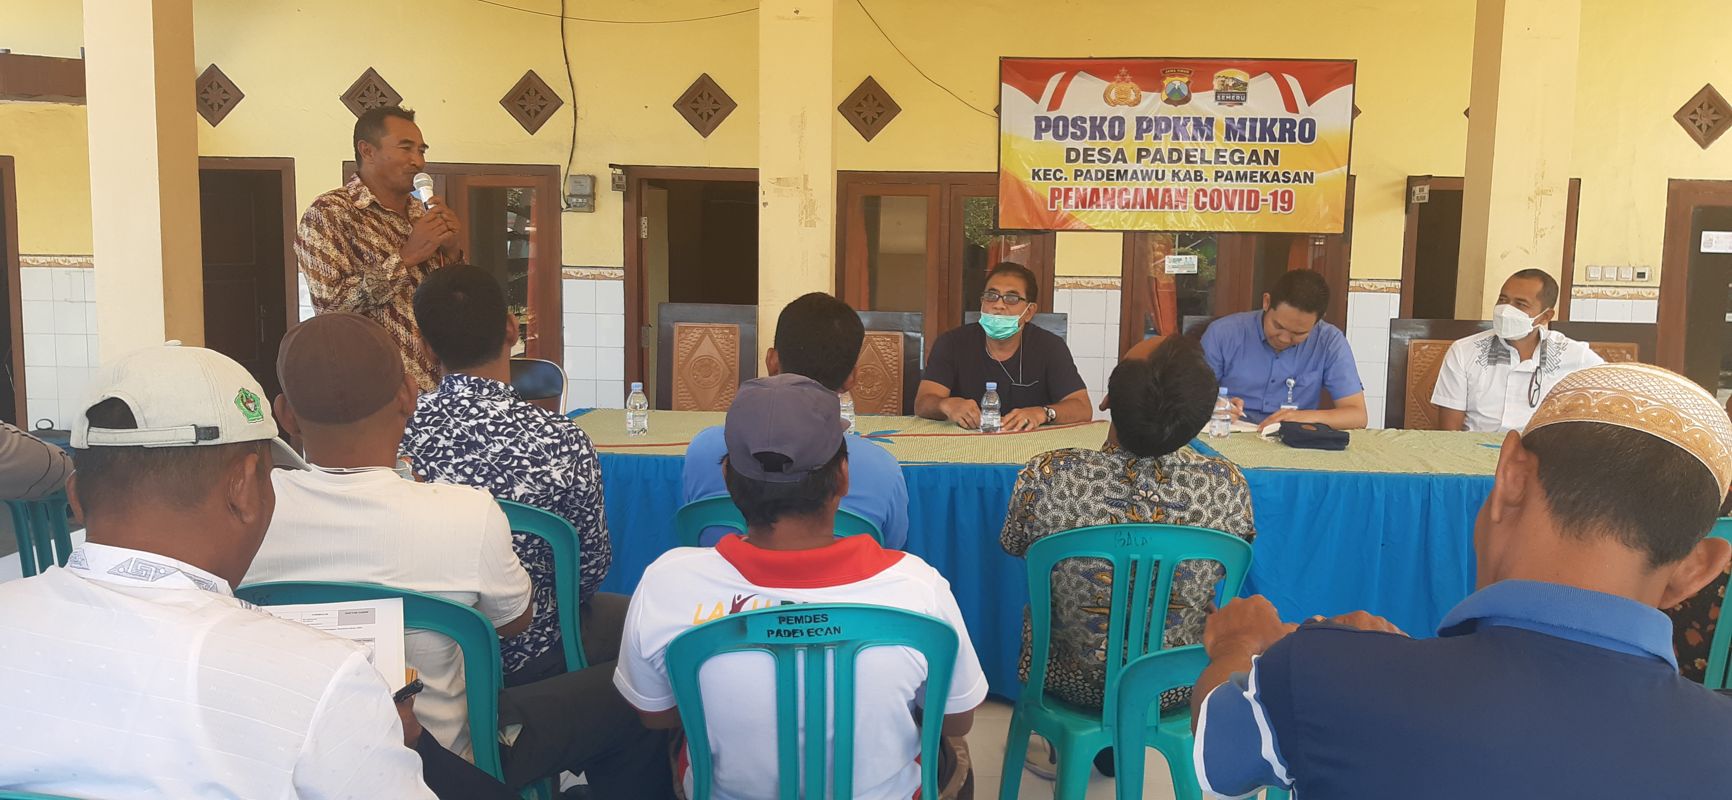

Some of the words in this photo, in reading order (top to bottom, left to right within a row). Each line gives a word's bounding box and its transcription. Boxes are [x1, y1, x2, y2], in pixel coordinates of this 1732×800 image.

[1033, 115, 1126, 141] POSKO
[1134, 115, 1215, 142] PPKM
[1224, 117, 1317, 144] MIKRO
[1065, 147, 1128, 164] DESA
[1136, 147, 1280, 166] PADELEGAN
[1031, 169, 1068, 181] KEC.
[1073, 169, 1166, 182] PADEMAWU
[1171, 169, 1208, 182] KAB.
[1213, 170, 1315, 184] PAMEKASAN
[1049, 187, 1188, 210] PENANGANAN
[1193, 188, 1294, 212] COVID-19
[777, 614, 829, 625] PEMDES
